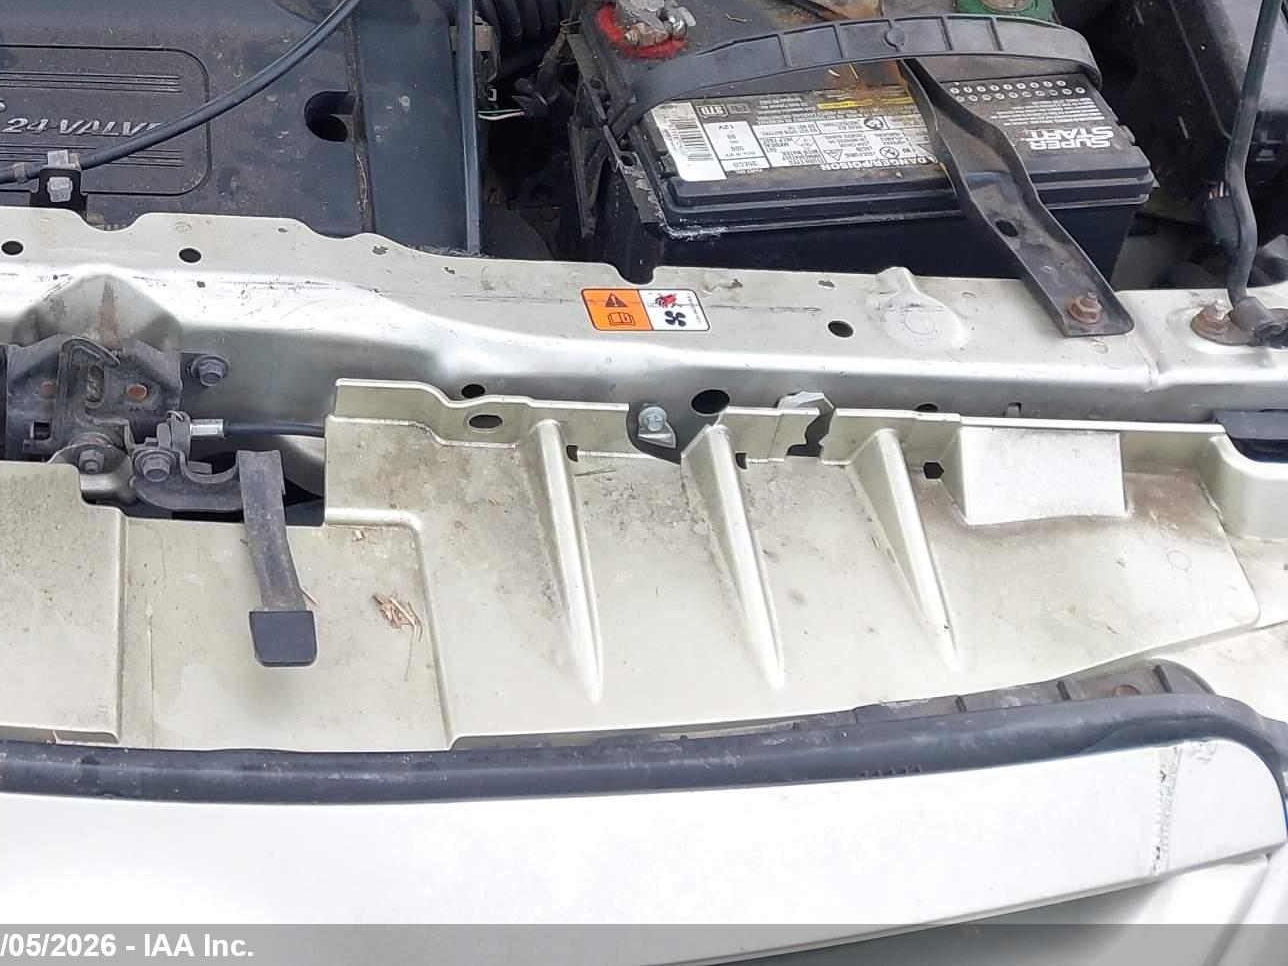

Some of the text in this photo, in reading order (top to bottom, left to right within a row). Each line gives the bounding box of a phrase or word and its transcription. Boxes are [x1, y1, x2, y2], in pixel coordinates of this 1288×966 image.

[2, 118, 48, 134] 24
[1021, 126, 1113, 141] START
[1030, 138, 1111, 150] SUPER
[820, 157, 927, 170] DANGER/POISON
